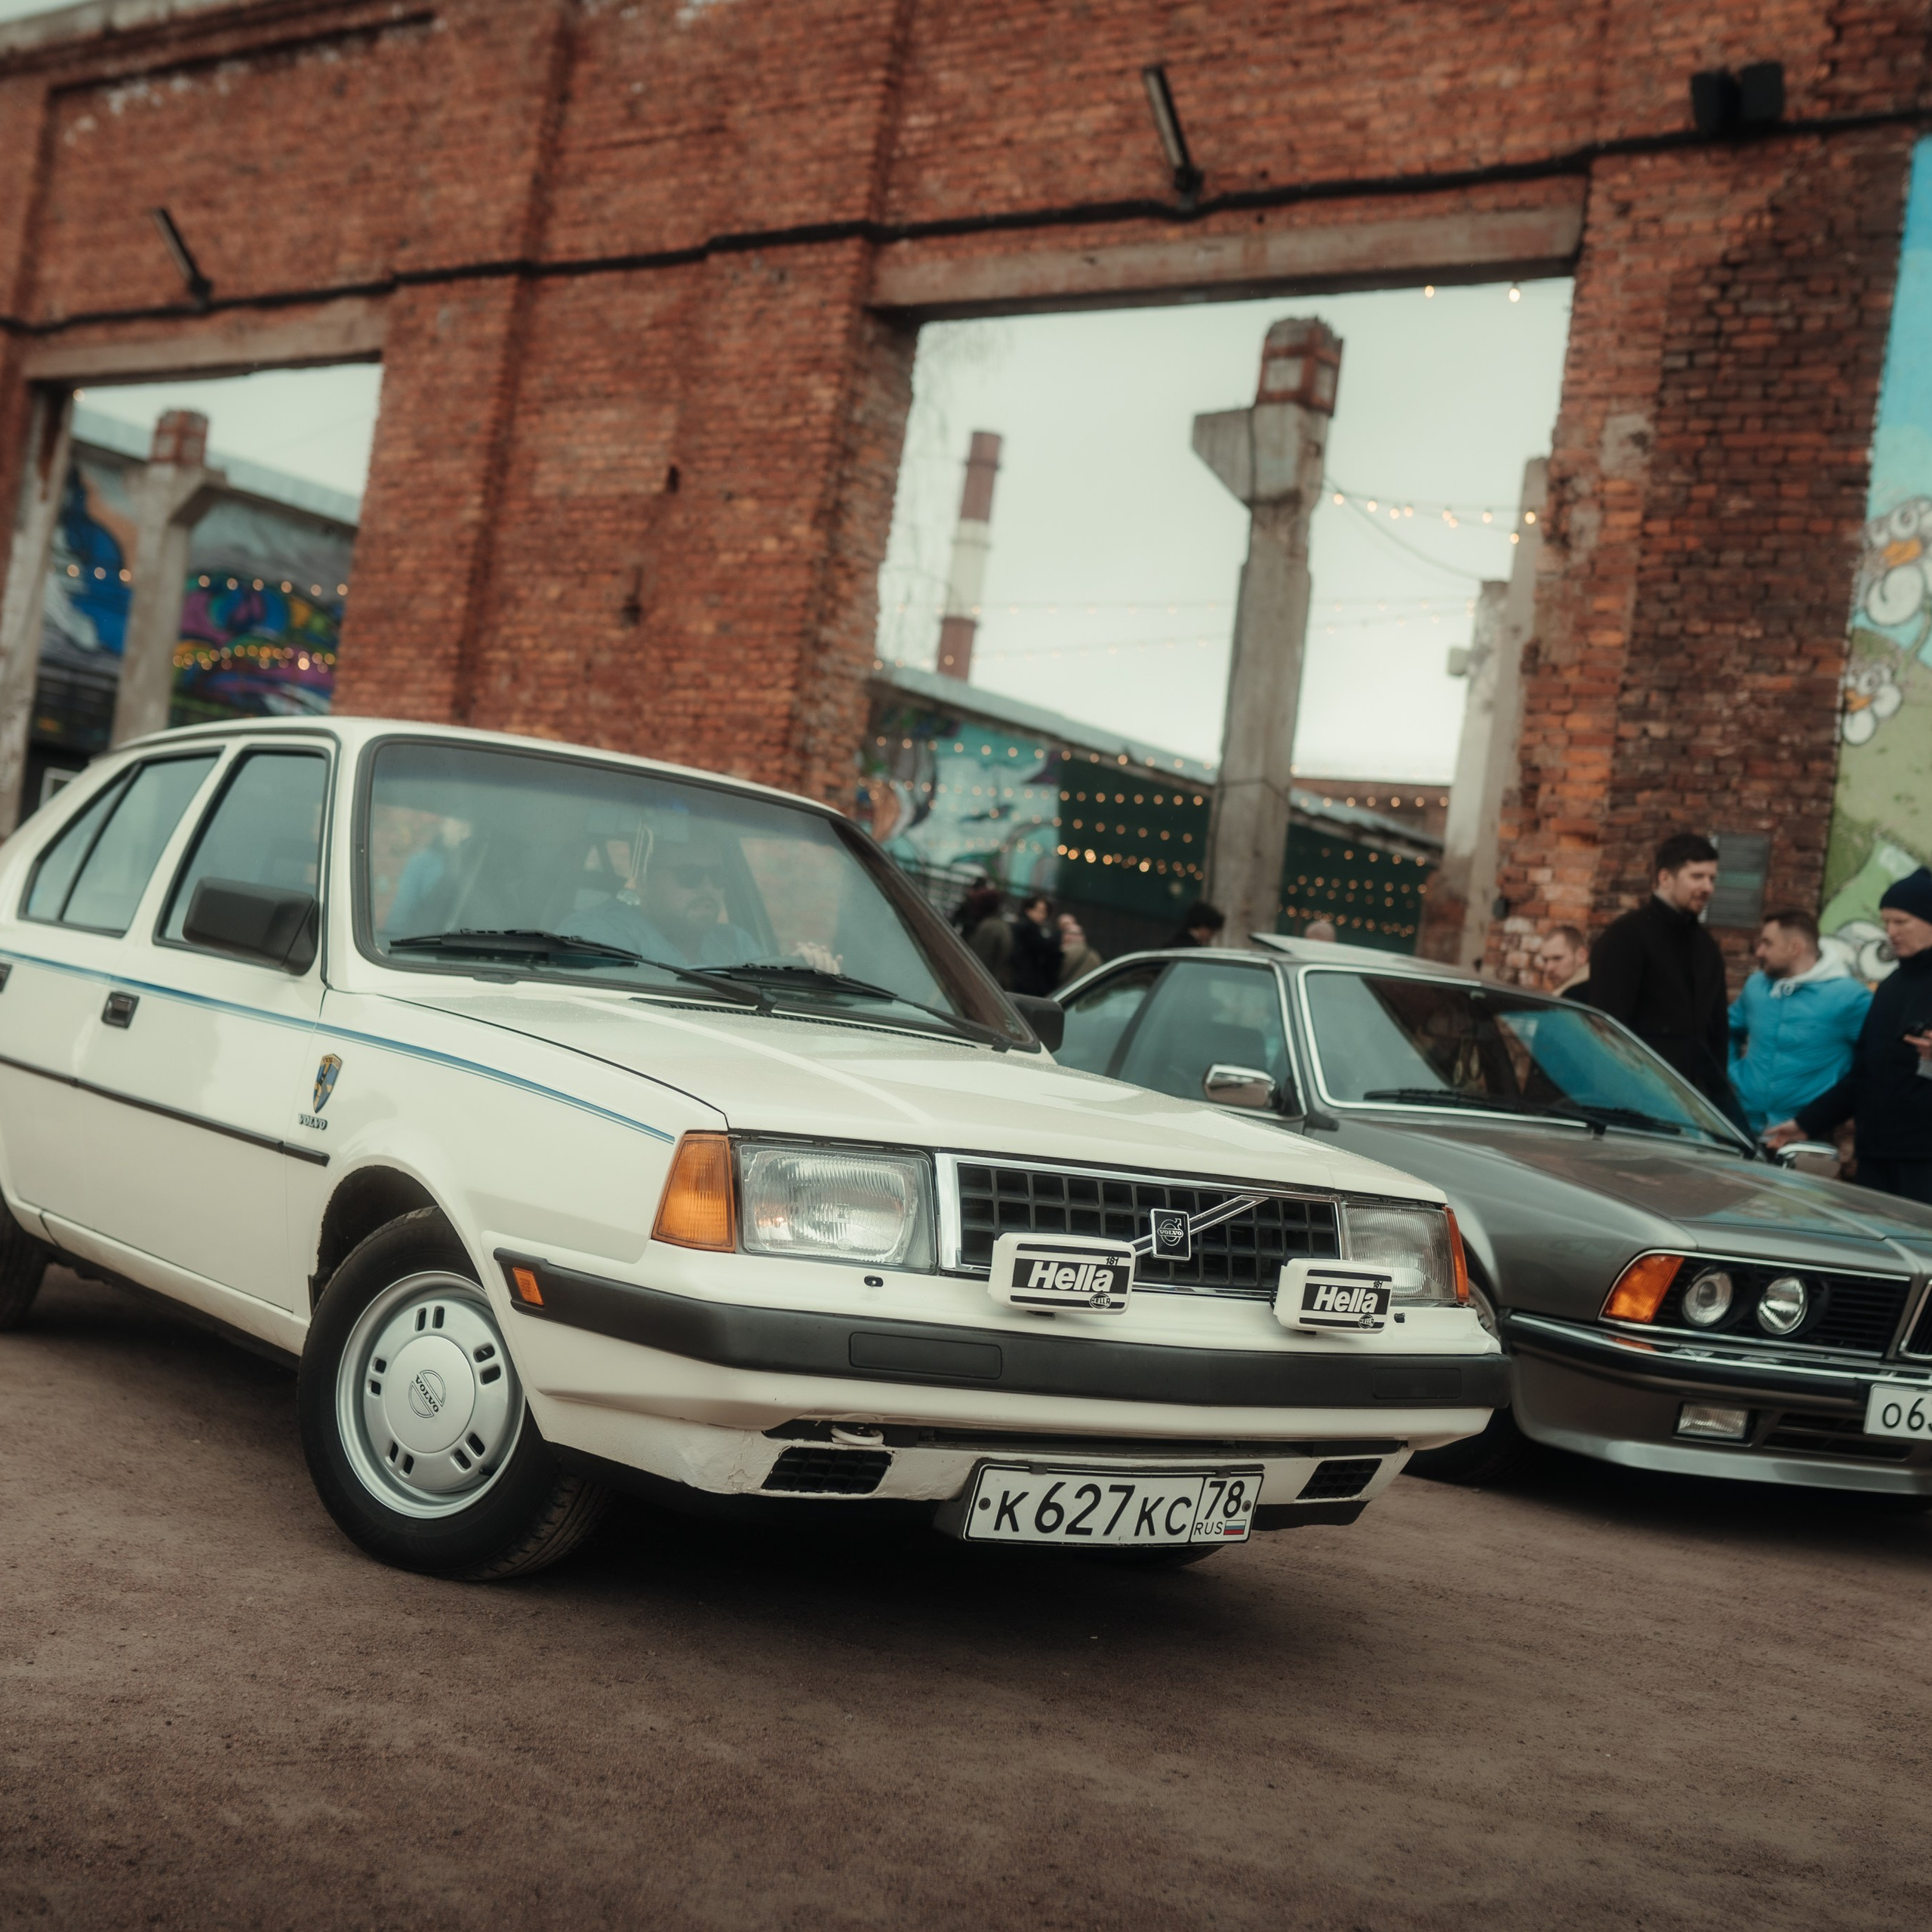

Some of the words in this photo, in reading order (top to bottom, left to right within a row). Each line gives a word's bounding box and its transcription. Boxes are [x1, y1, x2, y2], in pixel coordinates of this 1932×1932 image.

[298, 1114, 328, 1131] VOLVO
[1027, 1261, 1114, 1293] Hella
[1312, 1285, 1379, 1313] Hella
[415, 1374, 439, 1413] VOLVO
[1204, 1480, 1245, 1519] 78
[1194, 1521, 1223, 1536] RUS
